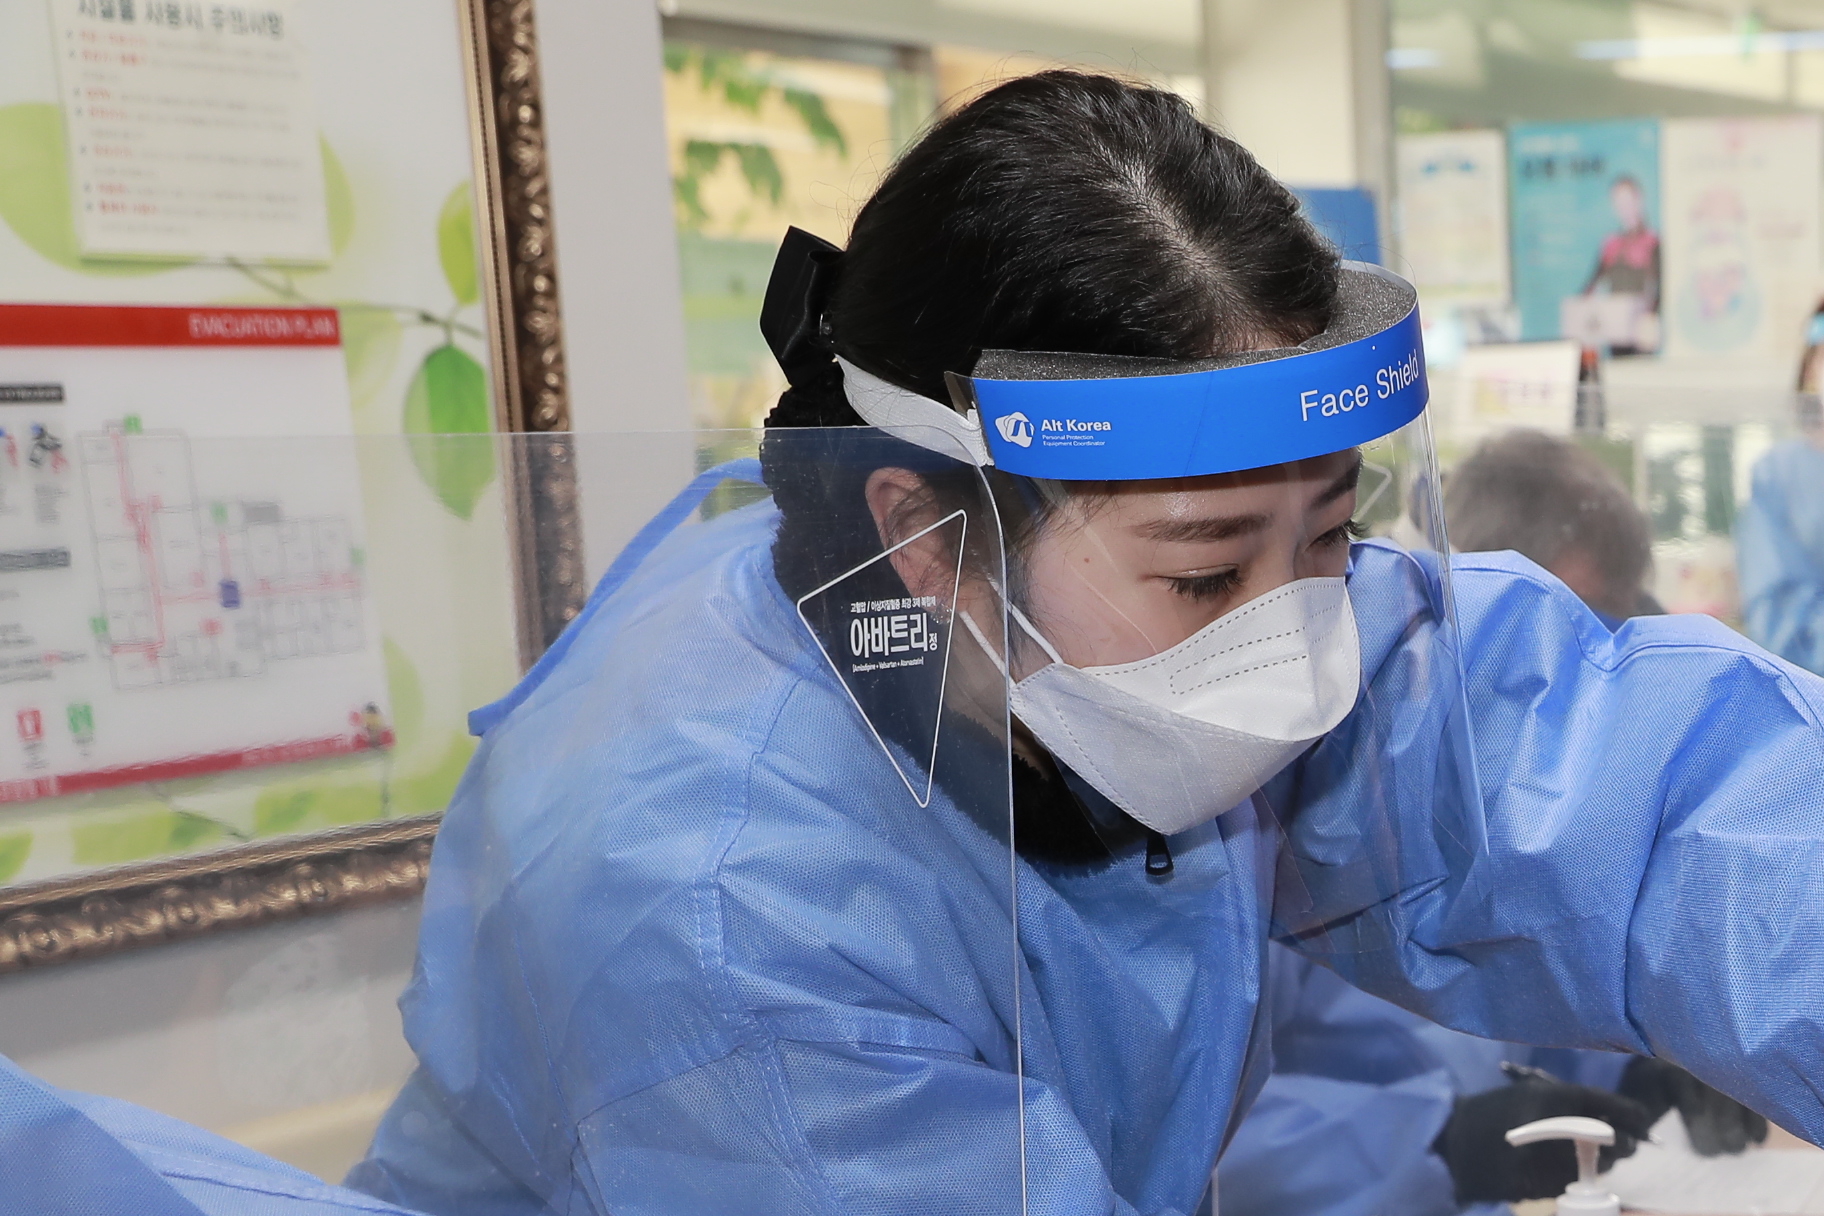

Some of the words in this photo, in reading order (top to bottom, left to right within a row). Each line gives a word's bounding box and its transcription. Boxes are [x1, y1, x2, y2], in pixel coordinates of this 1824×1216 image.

[189, 313, 292, 338] EVACUATION
[294, 314, 336, 339] PLAN
[1300, 384, 1369, 421] Face
[1376, 348, 1419, 399] Shield
[1041, 419, 1063, 432] Alt
[1066, 419, 1111, 432] Korea
